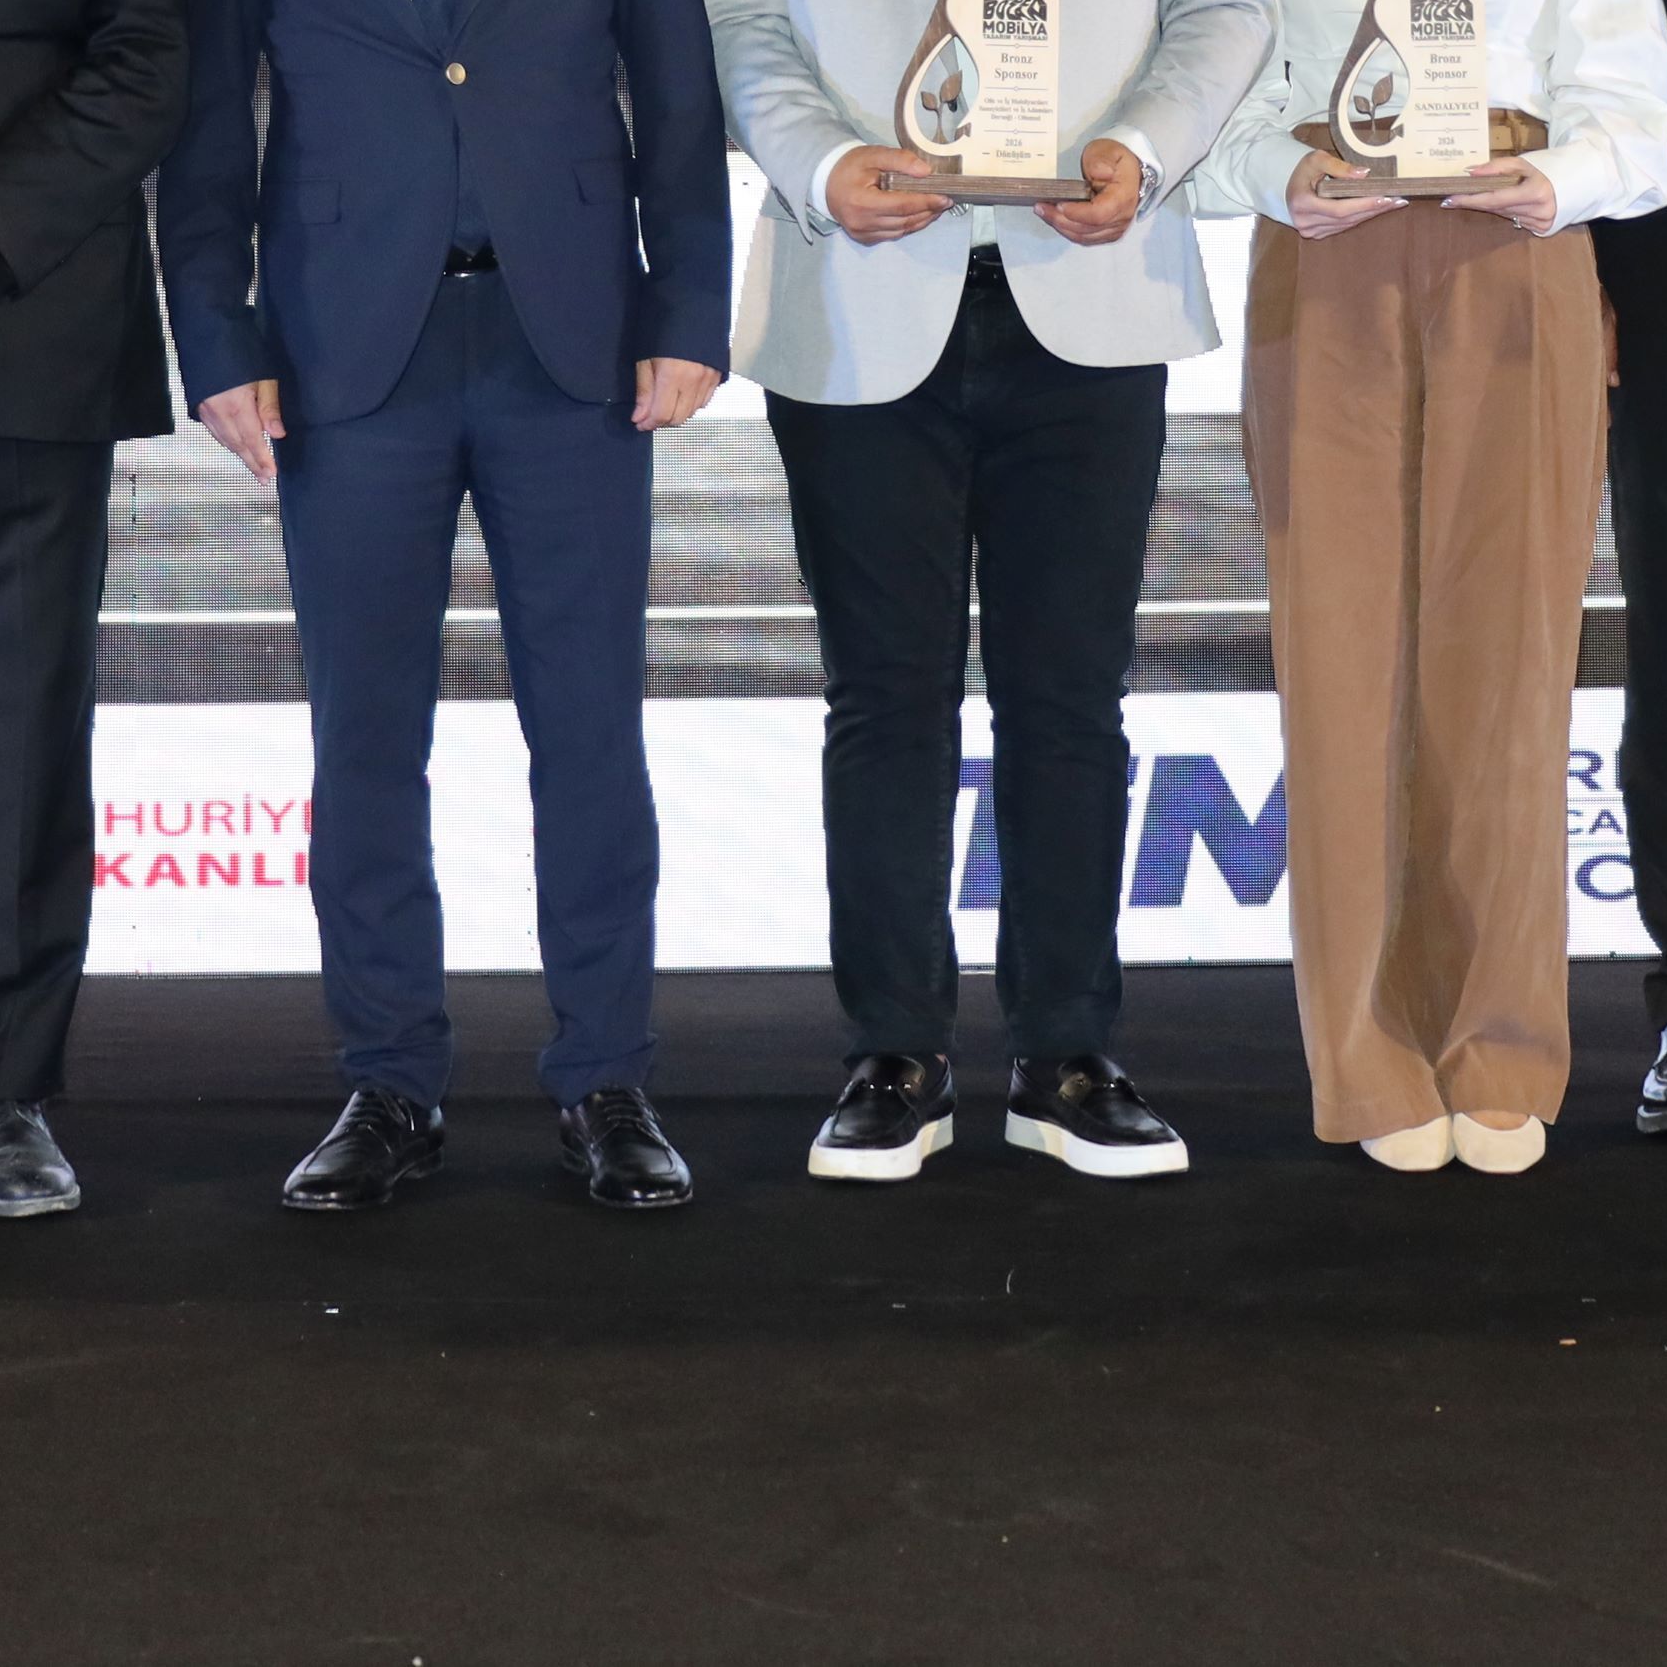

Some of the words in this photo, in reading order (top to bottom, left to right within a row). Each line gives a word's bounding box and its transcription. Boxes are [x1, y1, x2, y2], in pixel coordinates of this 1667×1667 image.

[1001, 53, 1033, 63] Bronz
[1430, 53, 1461, 64] Bronz
[994, 69, 1038, 81] Sponsor
[1424, 69, 1467, 82] Sponsor
